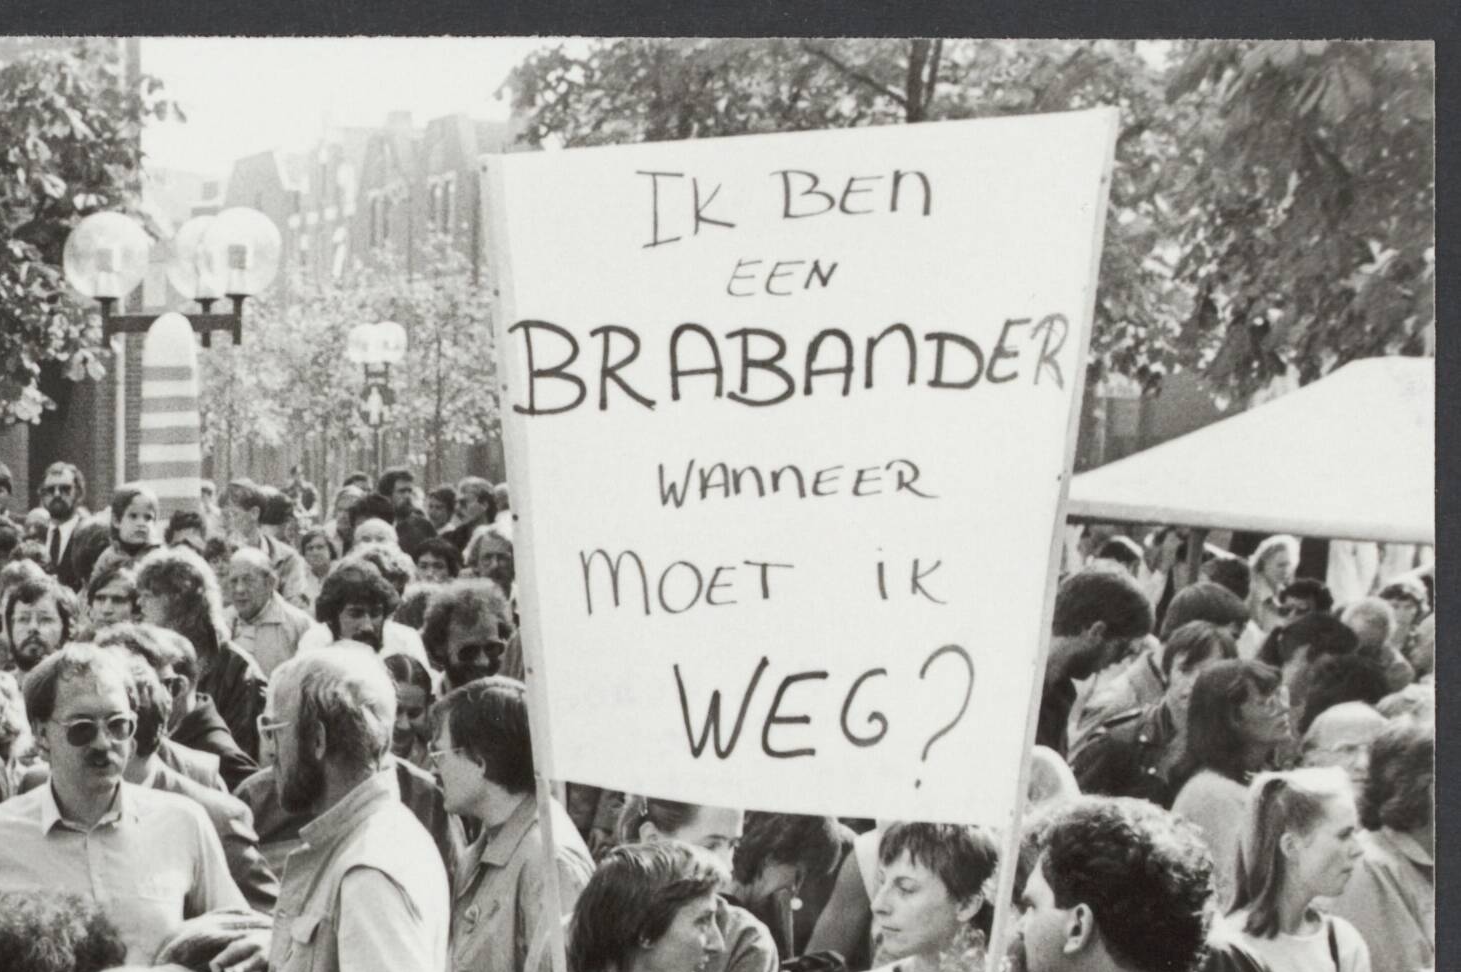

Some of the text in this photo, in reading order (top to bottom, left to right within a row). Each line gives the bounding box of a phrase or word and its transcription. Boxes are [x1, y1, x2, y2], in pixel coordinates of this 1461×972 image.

[636, 170, 933, 249] IK BEN
[727, 259, 840, 298] EEN
[507, 313, 1070, 417] BRABANDER
[579, 549, 795, 617] MOET
[674, 644, 976, 790] WEG?
